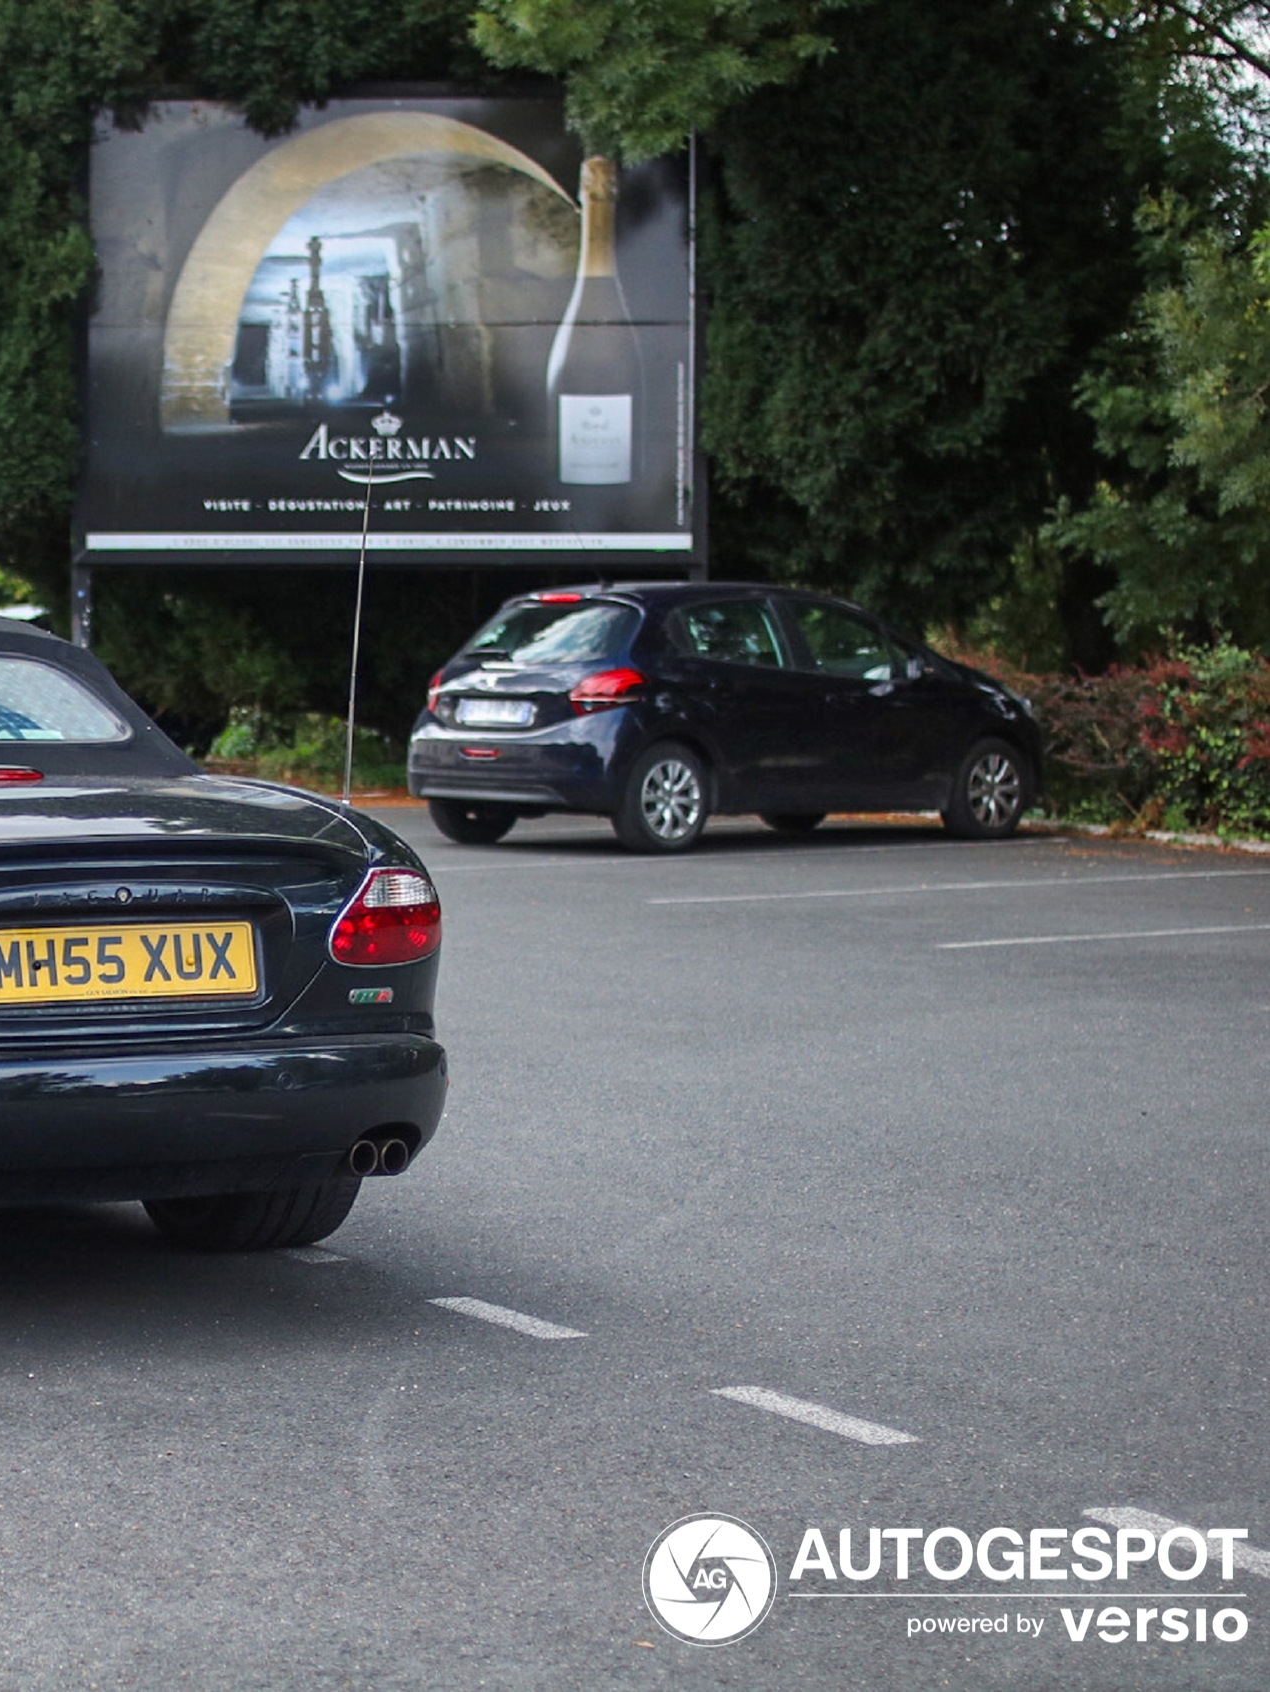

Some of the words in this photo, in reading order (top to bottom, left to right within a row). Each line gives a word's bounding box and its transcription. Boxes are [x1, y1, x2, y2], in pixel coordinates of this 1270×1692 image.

[299, 422, 476, 460] ACKERMAN
[203, 499, 251, 511] VISITE
[383, 499, 411, 511] ART
[428, 499, 515, 511] PATRIMOINE
[533, 499, 571, 511] JEUX
[33, 887, 211, 907] JAGUAR
[140, 932, 237, 982] XUX
